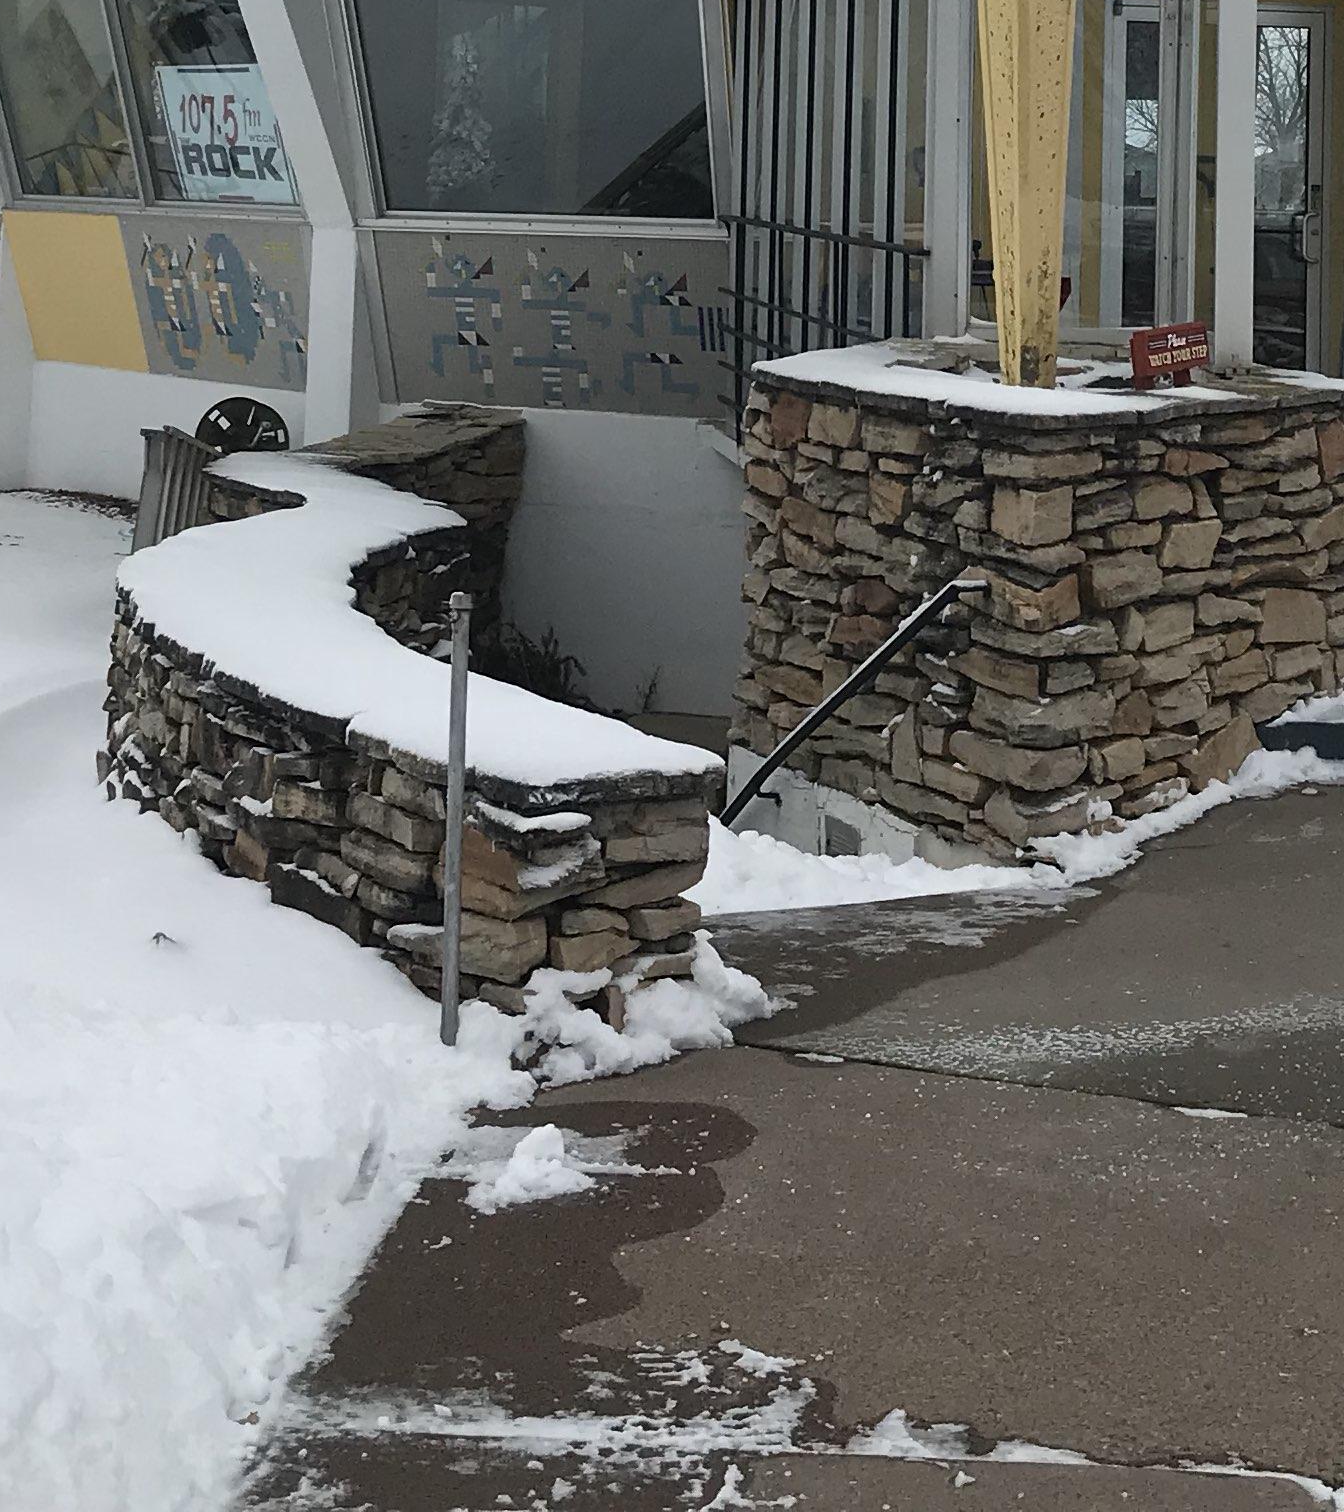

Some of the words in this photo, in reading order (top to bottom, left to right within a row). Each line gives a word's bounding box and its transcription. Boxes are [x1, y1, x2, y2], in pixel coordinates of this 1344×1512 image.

[179, 94, 239, 147] 107.5
[181, 143, 284, 181] ROCK
[1172, 348, 1192, 363] YOUR
[1191, 344, 1208, 359] STEP
